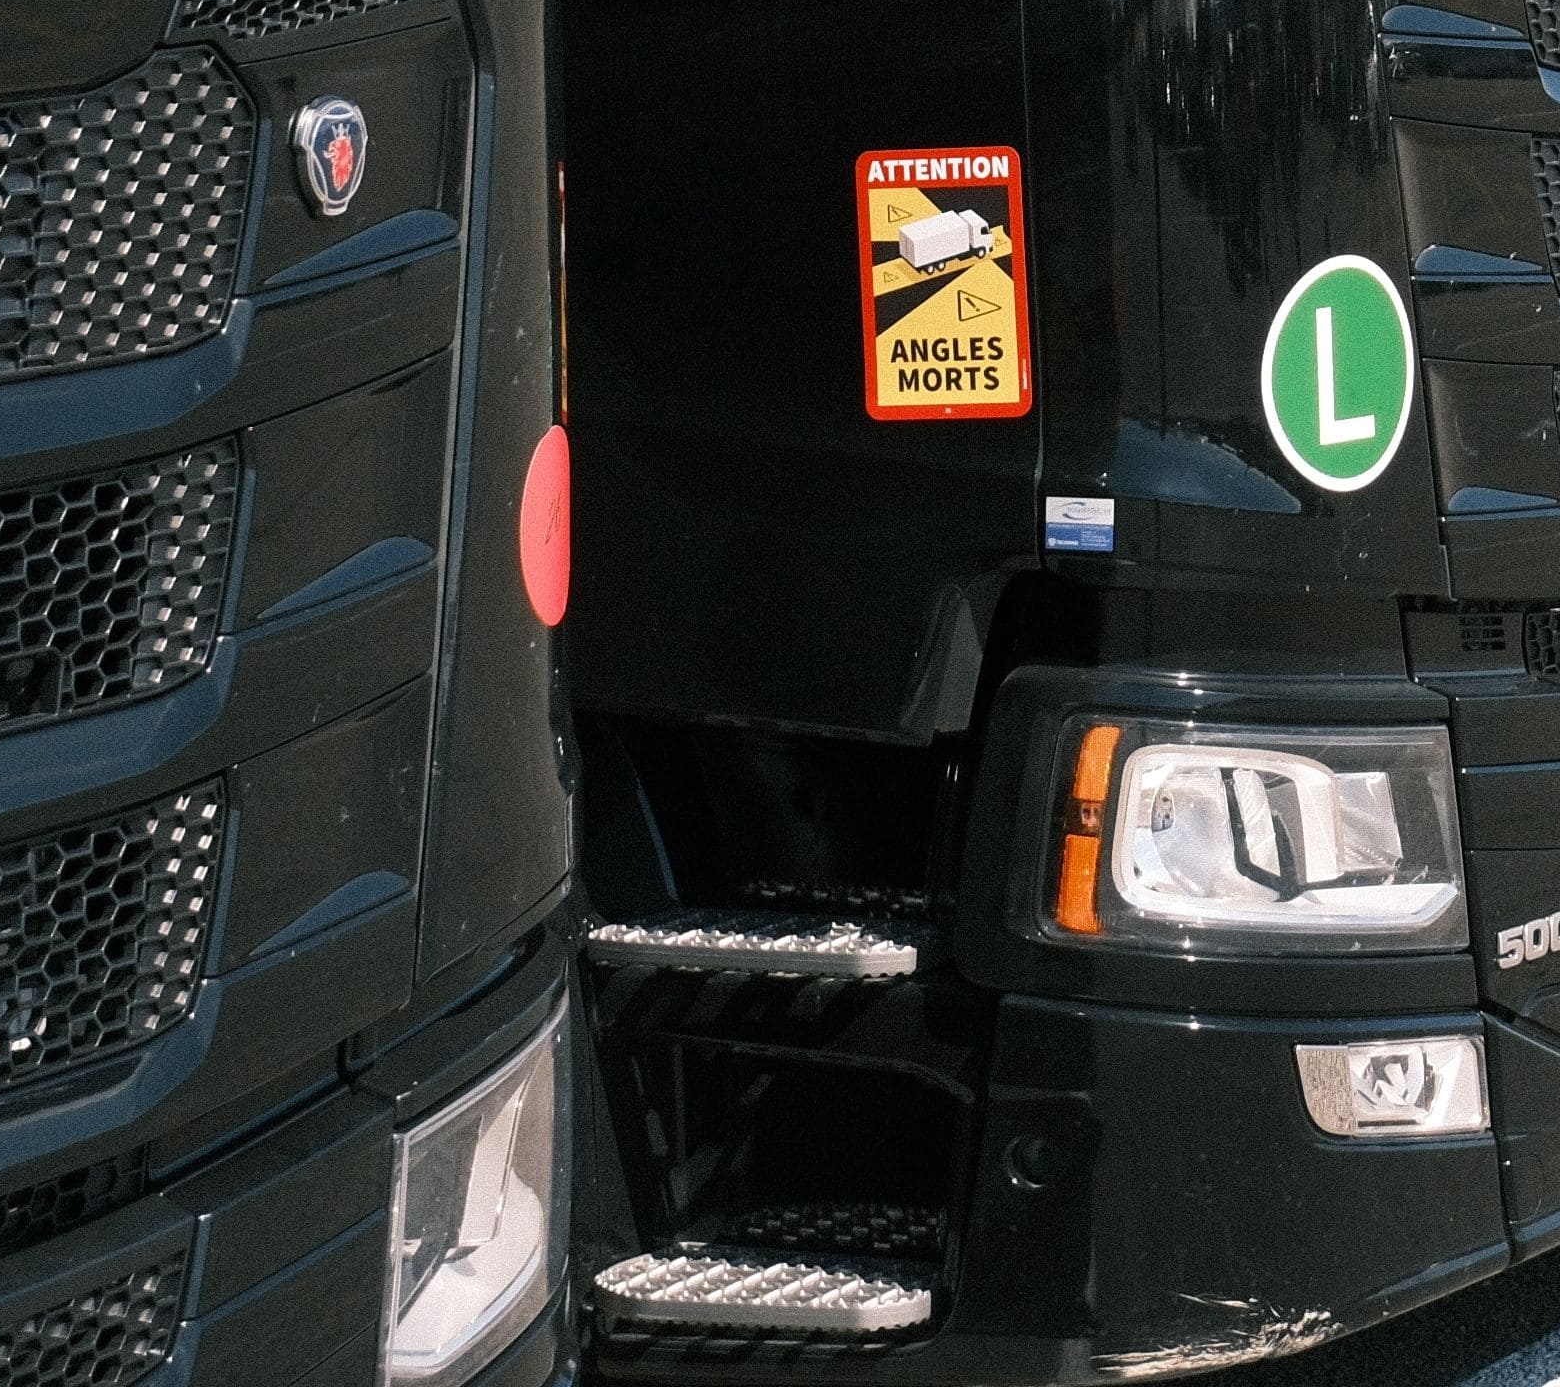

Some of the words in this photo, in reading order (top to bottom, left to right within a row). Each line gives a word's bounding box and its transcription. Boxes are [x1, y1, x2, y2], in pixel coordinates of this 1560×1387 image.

[867, 155, 1010, 183] ATTENTION
[890, 336, 1005, 364] ANGLES
[896, 366, 1001, 394] MORTS
[1315, 306, 1377, 447] L
